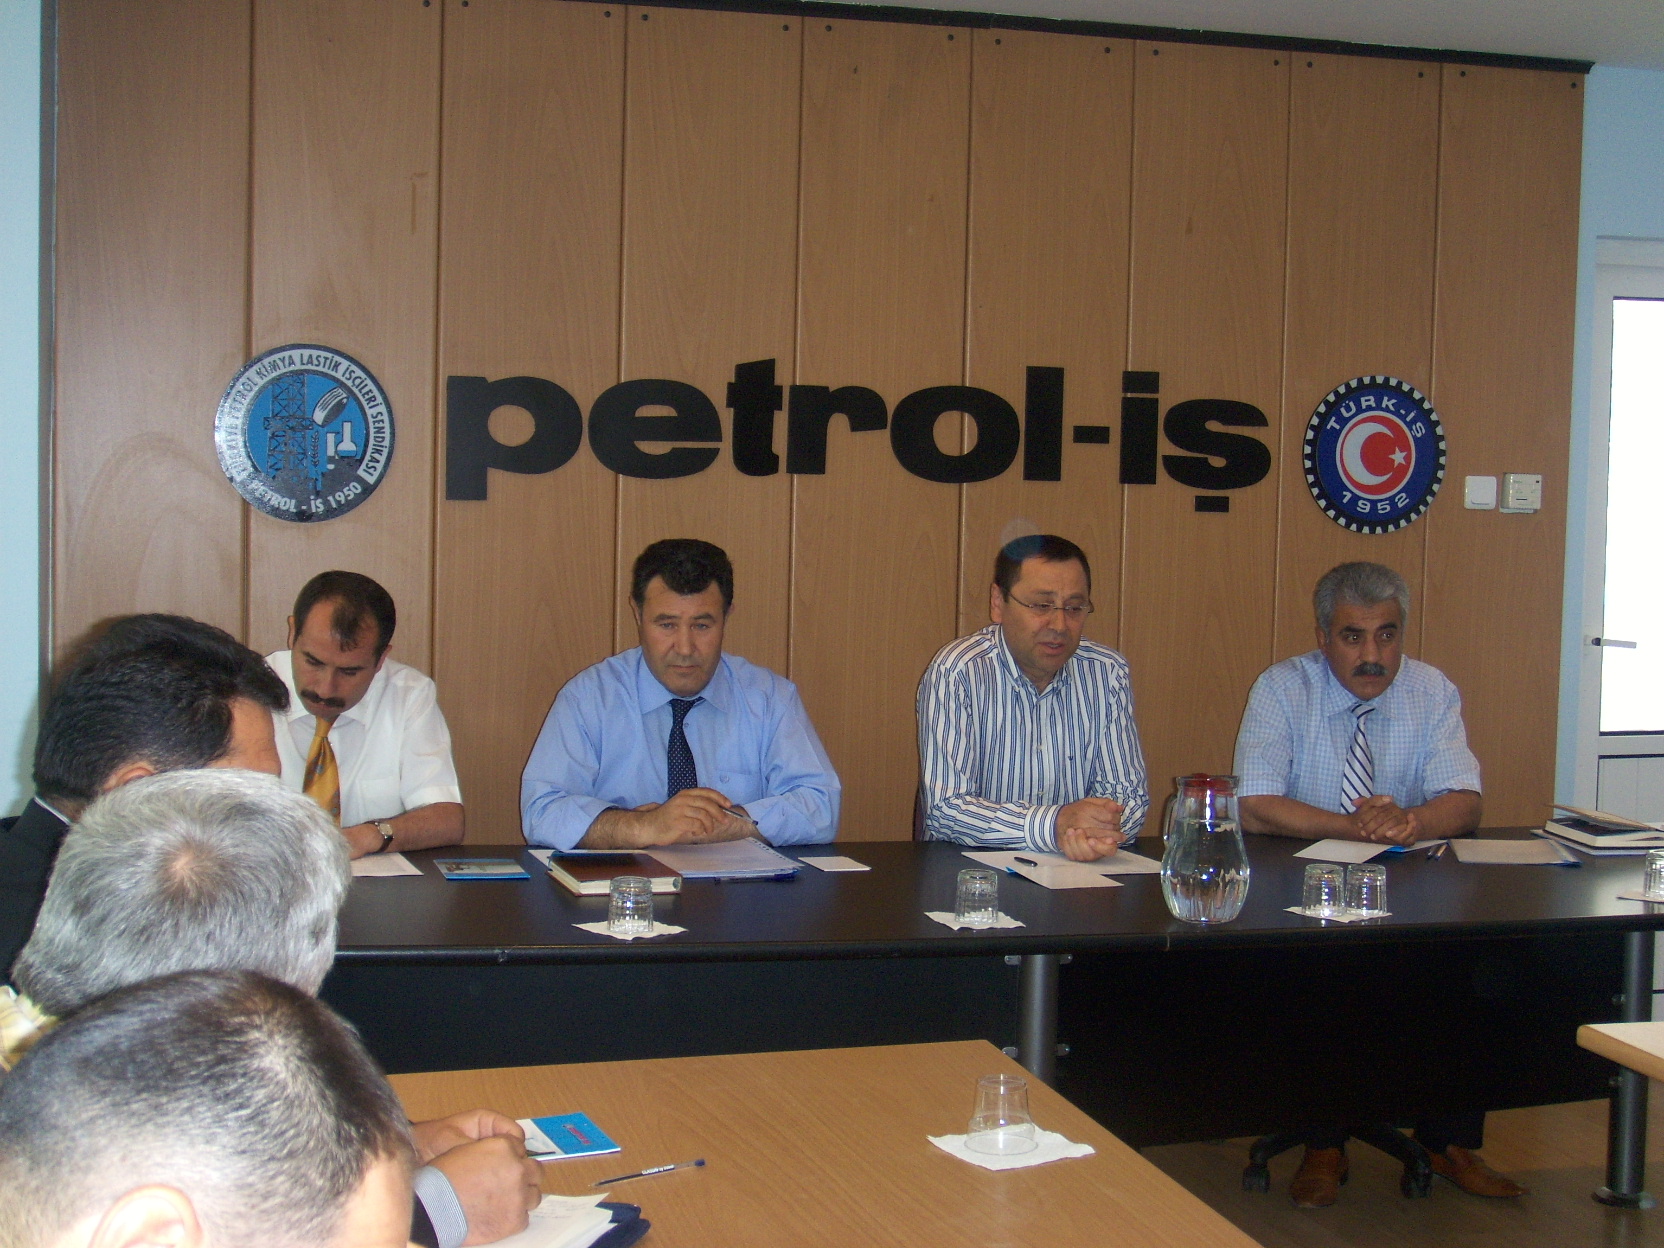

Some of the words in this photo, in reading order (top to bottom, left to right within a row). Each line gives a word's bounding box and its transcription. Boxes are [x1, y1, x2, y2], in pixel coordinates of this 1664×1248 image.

[256, 355, 296, 381] KİMYA
[299, 353, 343, 373] LASTİK
[342, 364, 382, 410] İŞÇİLERİ
[368, 411, 388, 477] SENDİKASI
[445, 358, 1272, 513] petrol-iş
[1326, 395, 1426, 438] TÜRK-İŞ
[327, 481, 363, 509] 1950
[1342, 491, 1410, 515] 1952
